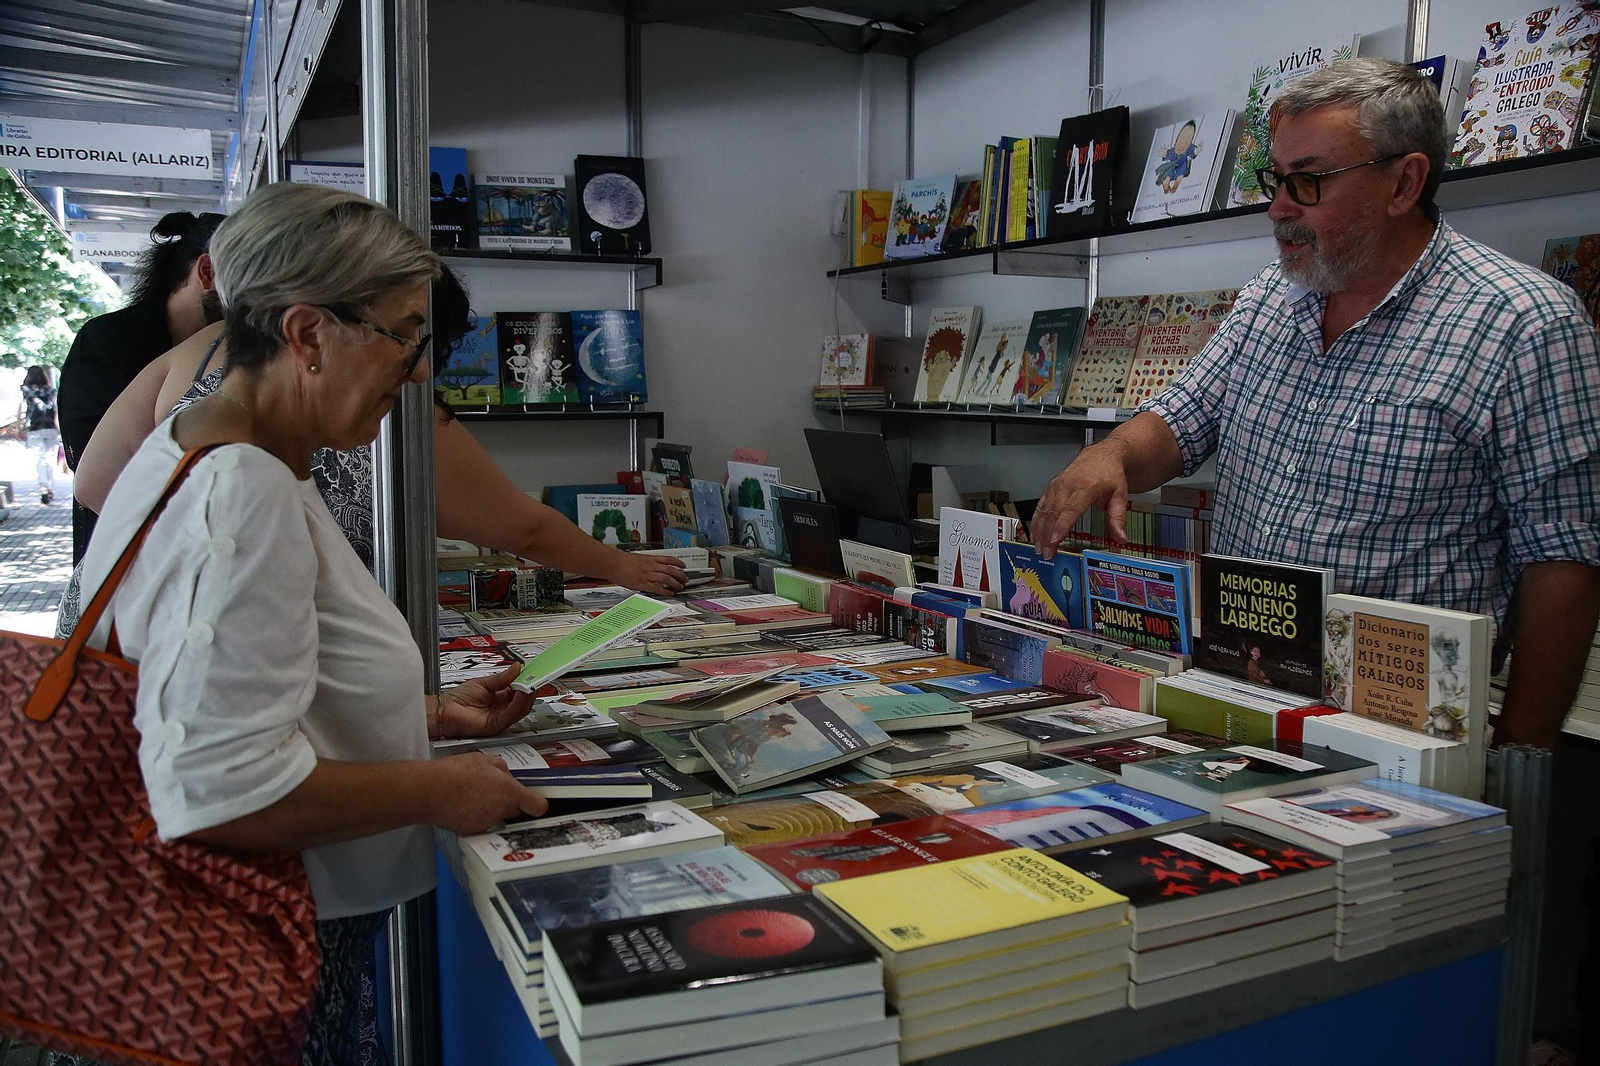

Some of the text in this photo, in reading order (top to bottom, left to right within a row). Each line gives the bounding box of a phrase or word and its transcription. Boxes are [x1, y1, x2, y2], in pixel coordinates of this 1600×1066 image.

[1514, 45, 1542, 67] GUÍA
[1494, 60, 1553, 86] ILUSTRADA
[1499, 74, 1555, 98] ENTROIDO
[1496, 92, 1541, 113] GALEGO
[36, 147, 128, 163] EDITORIAL
[132, 152, 210, 170] (ALLARIZ)
[501, 176, 517, 185] VIVEN
[527, 177, 556, 186] MONSTROS
[1151, 335, 1181, 345] ROCHAS
[949, 519, 995, 551] Gnomos
[1220, 572, 1297, 601] MEMORIAS
[1220, 590, 1297, 620] DUN NENO
[1099, 605, 1171, 638] SALVAXE VIDA
[1220, 606, 1297, 640] LABREGO
[1358, 618, 1425, 641] Dicionario
[1358, 634, 1425, 657] dos seres
[1357, 649, 1425, 674] MÍTICOS
[1357, 665, 1425, 691] GALEGOS
[1363, 698, 1390, 710] Antonio
[1001, 857, 1041, 879] CONTO
[1037, 876, 1086, 903] GALEGO
[1073, 882, 1094, 896] DO
